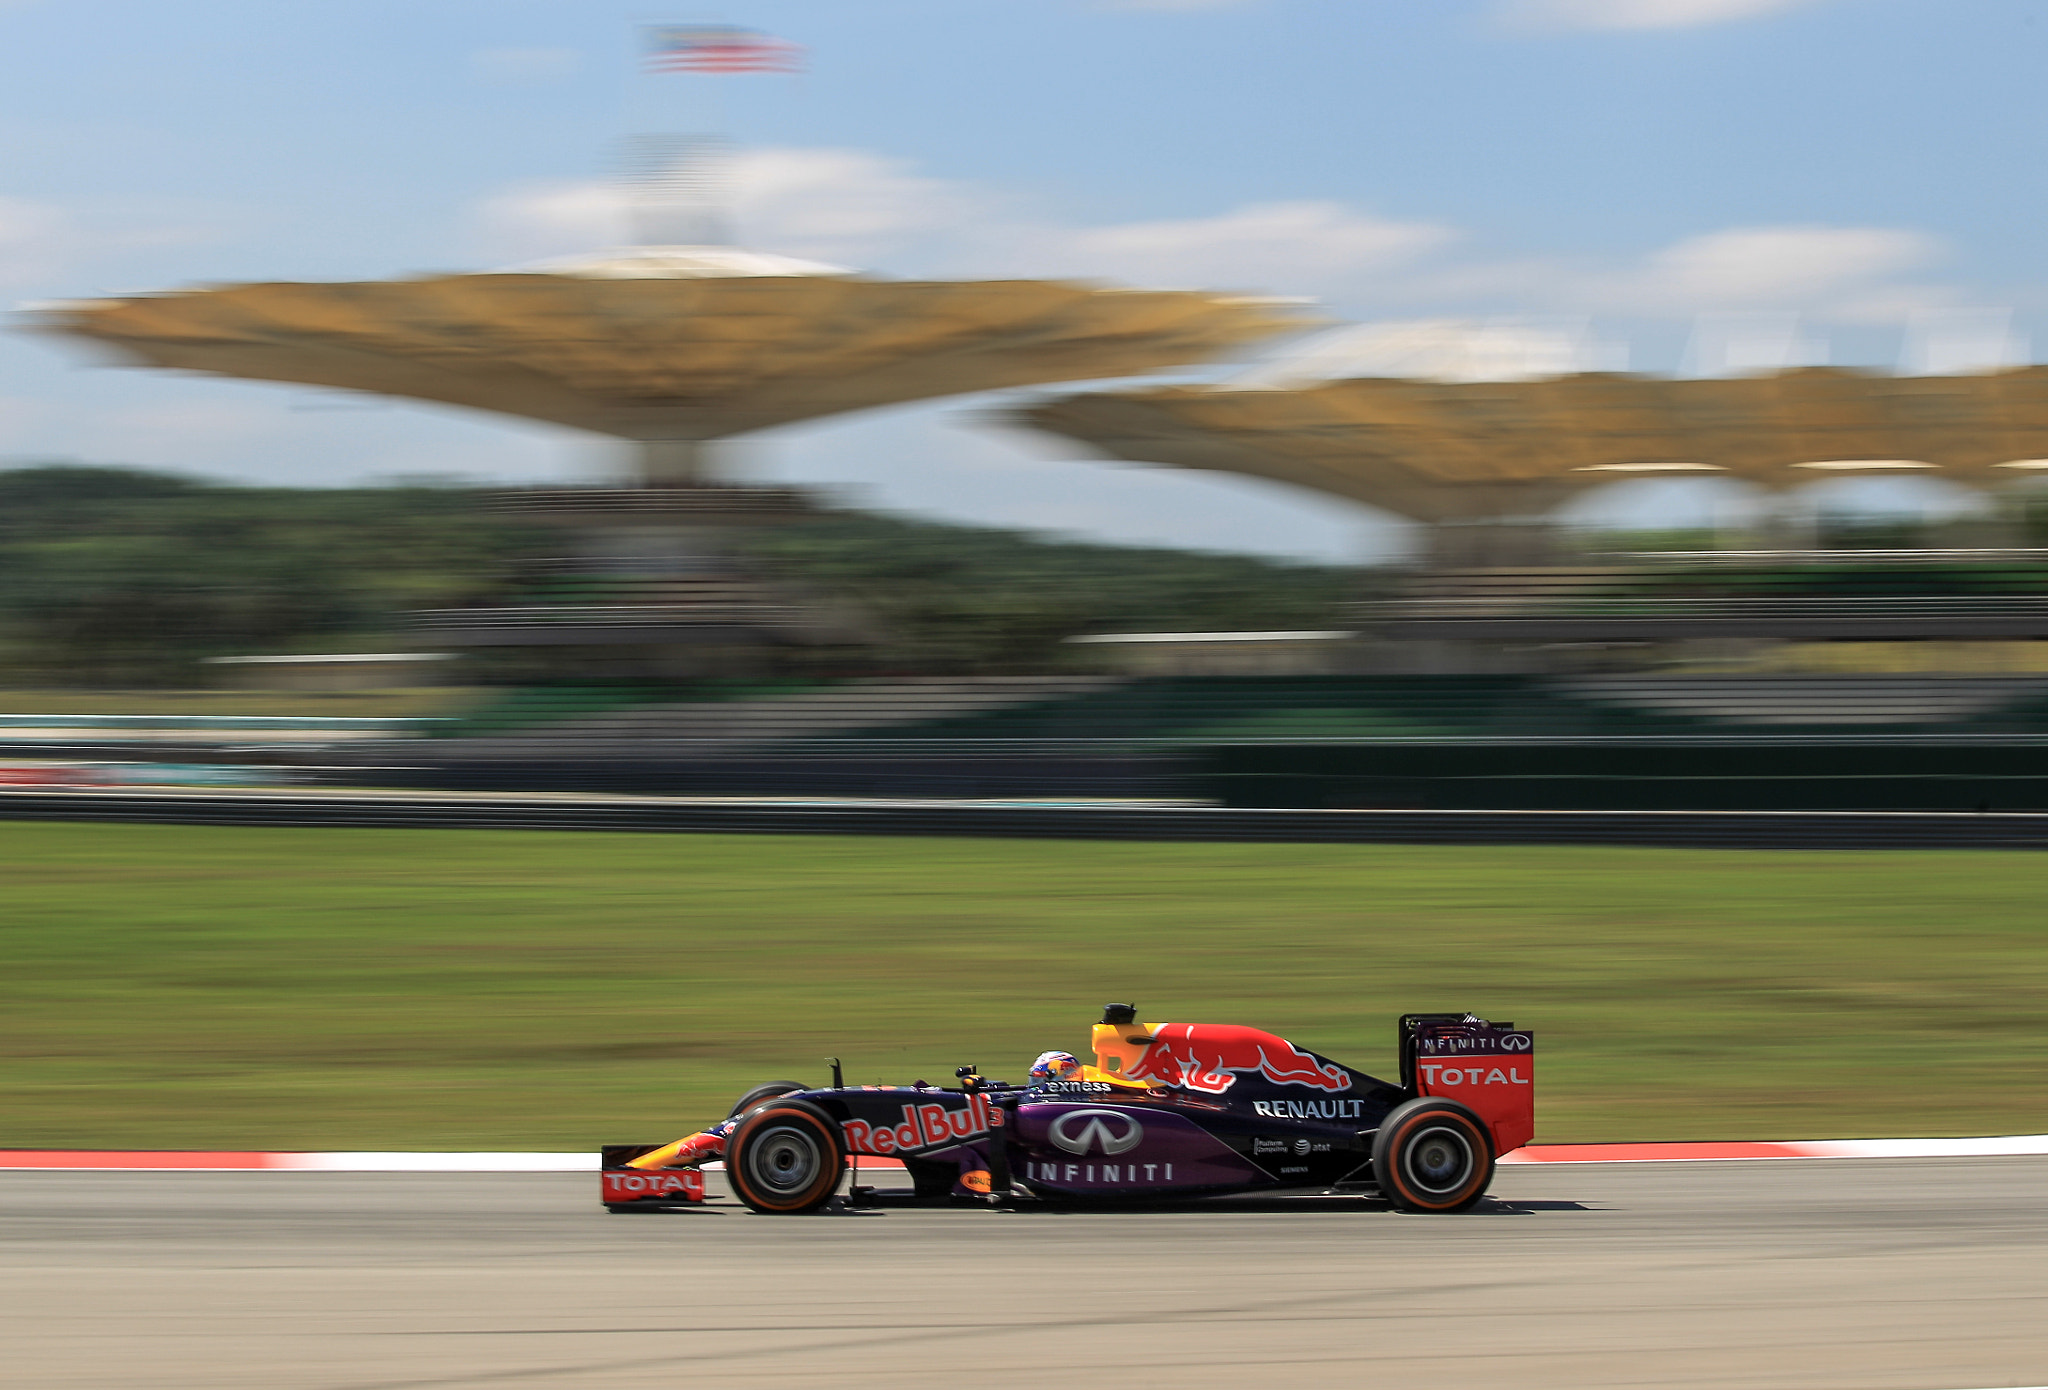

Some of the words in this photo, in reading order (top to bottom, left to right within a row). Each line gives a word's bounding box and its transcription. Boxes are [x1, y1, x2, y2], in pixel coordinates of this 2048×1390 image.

[1420, 1064, 1528, 1086] TOTAL
[1048, 1081, 1112, 1093] exness
[988, 1106, 1005, 1127] 3
[1252, 1099, 1365, 1119] RENAULT
[1026, 1161, 1173, 1182] INFINITI
[605, 1173, 701, 1192] TOTAL
